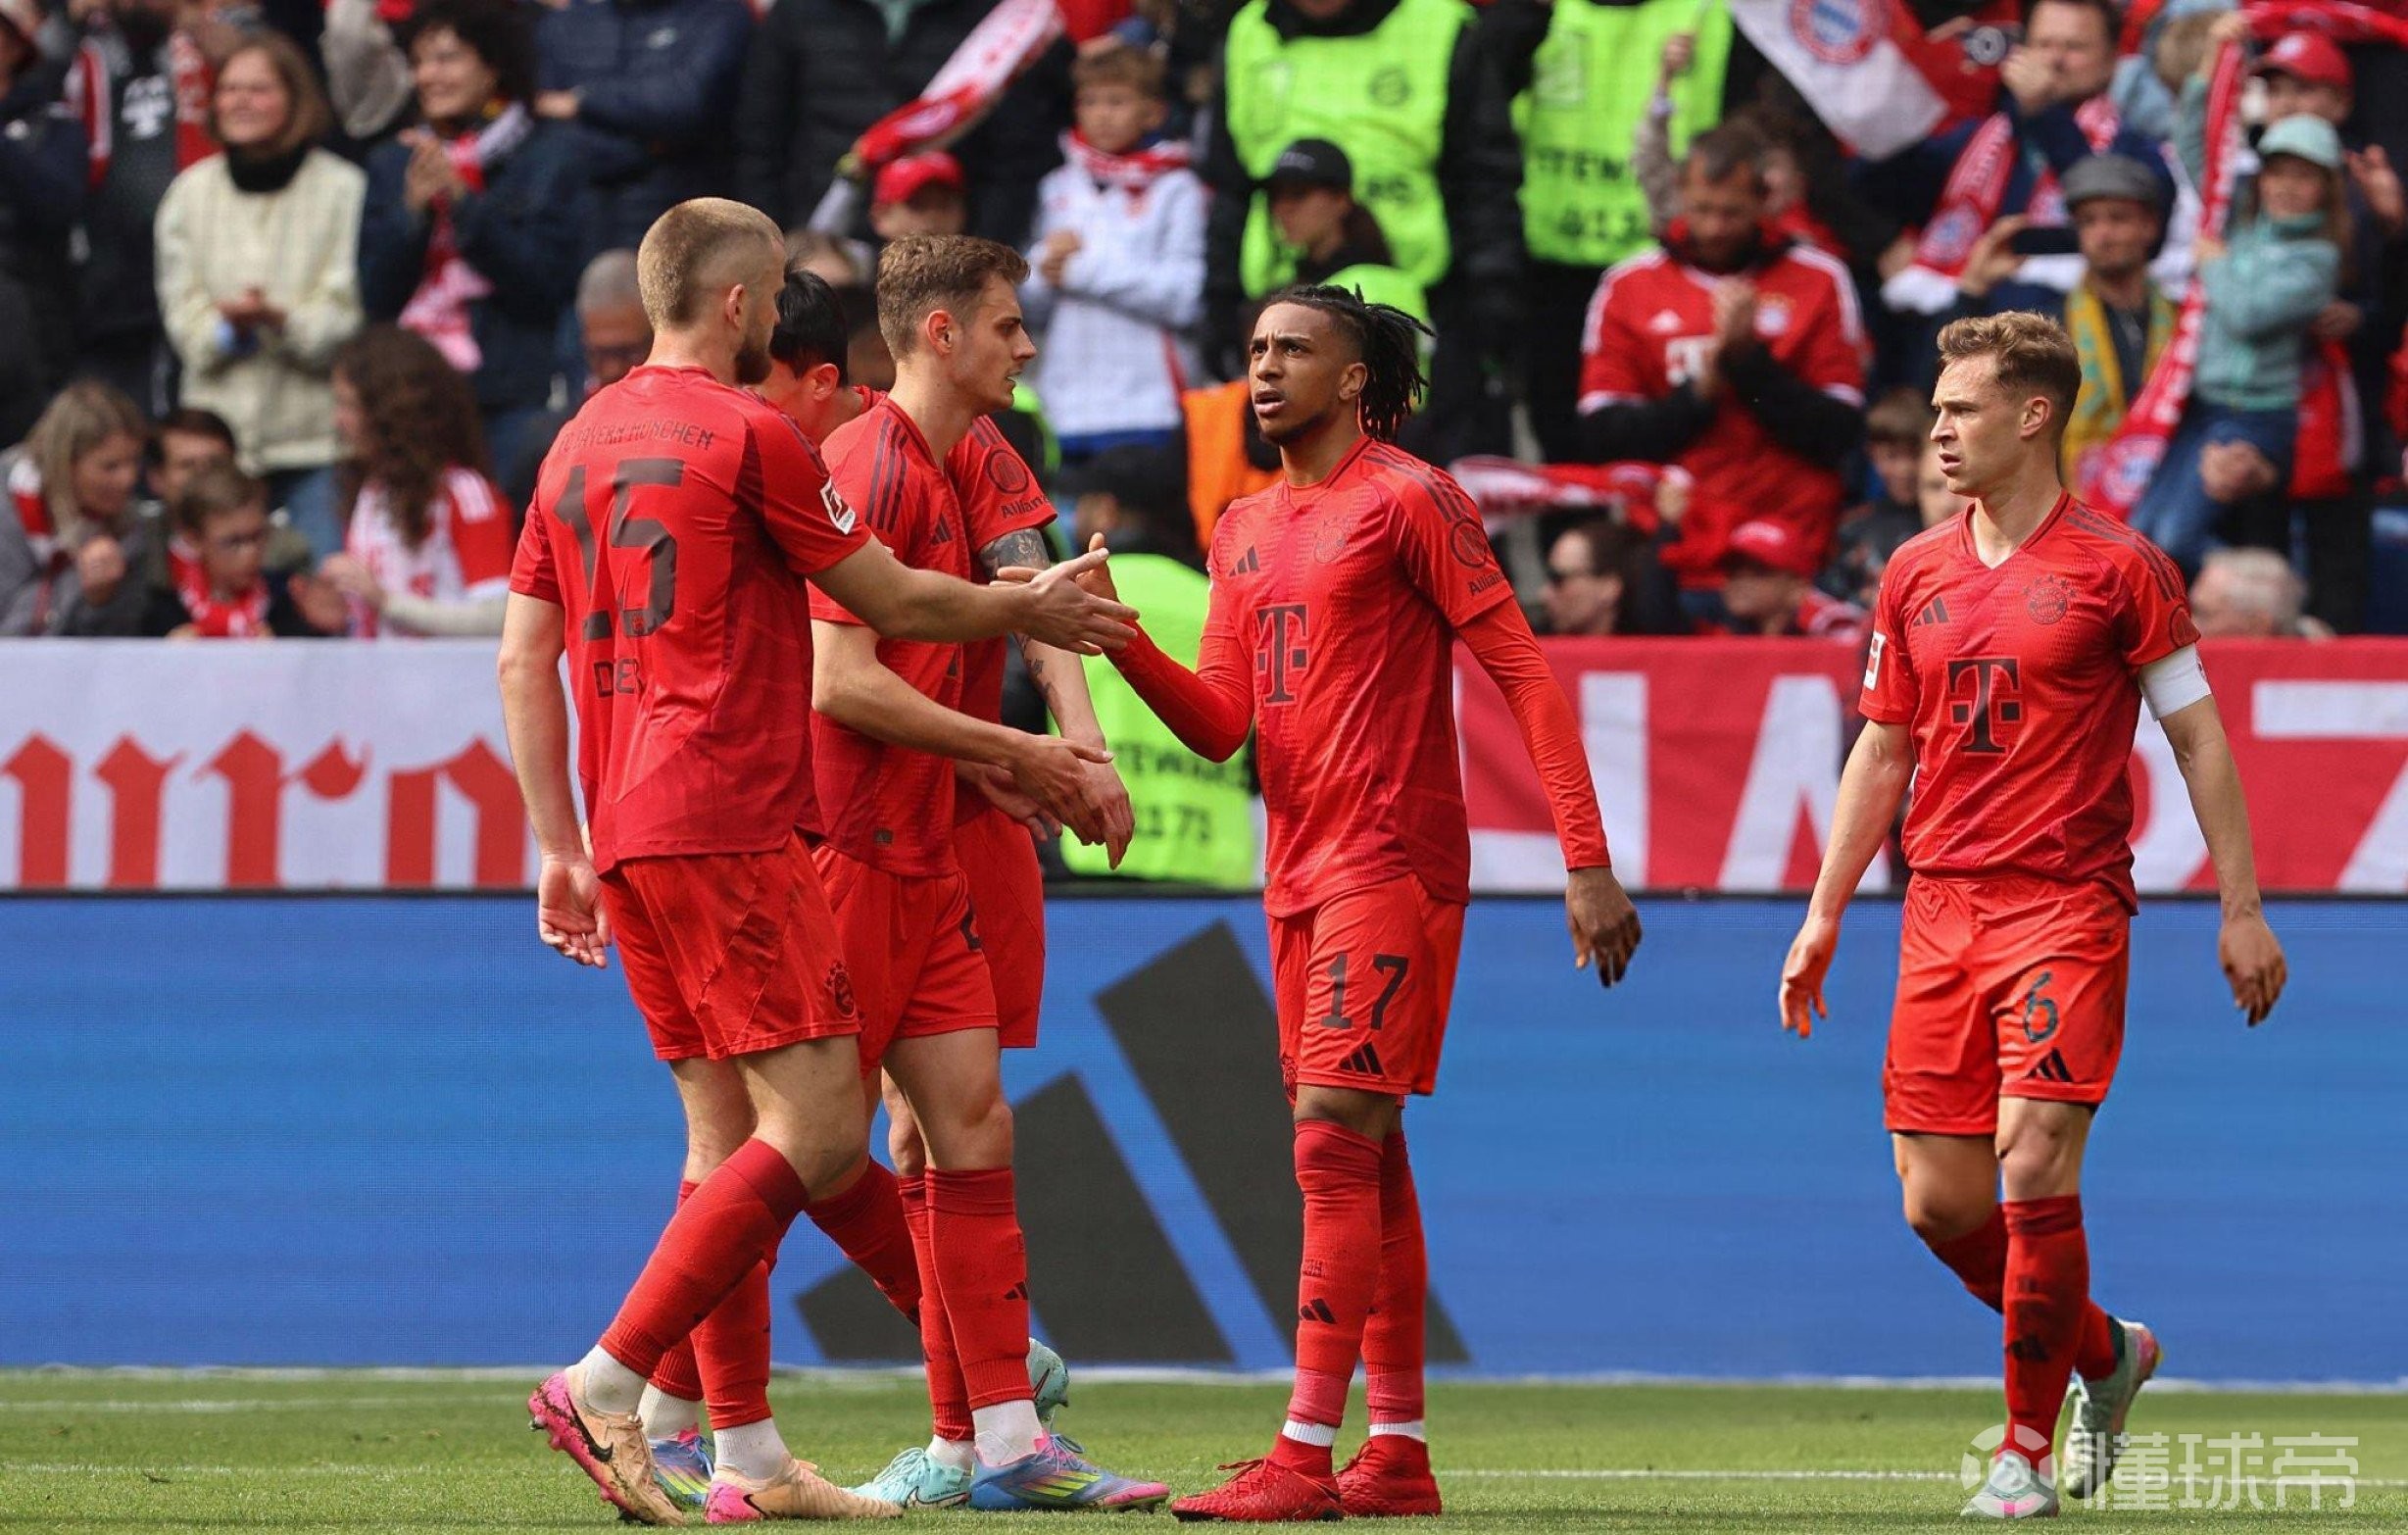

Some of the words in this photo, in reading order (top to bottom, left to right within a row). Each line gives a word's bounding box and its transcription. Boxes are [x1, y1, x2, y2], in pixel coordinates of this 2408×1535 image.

[554, 458, 684, 643] 15
[1468, 571, 1503, 596] Allian
[1255, 604, 1308, 704] T
[1947, 658, 2021, 753] T
[1320, 951, 1408, 1030] 17
[2024, 971, 2057, 1043] 6
